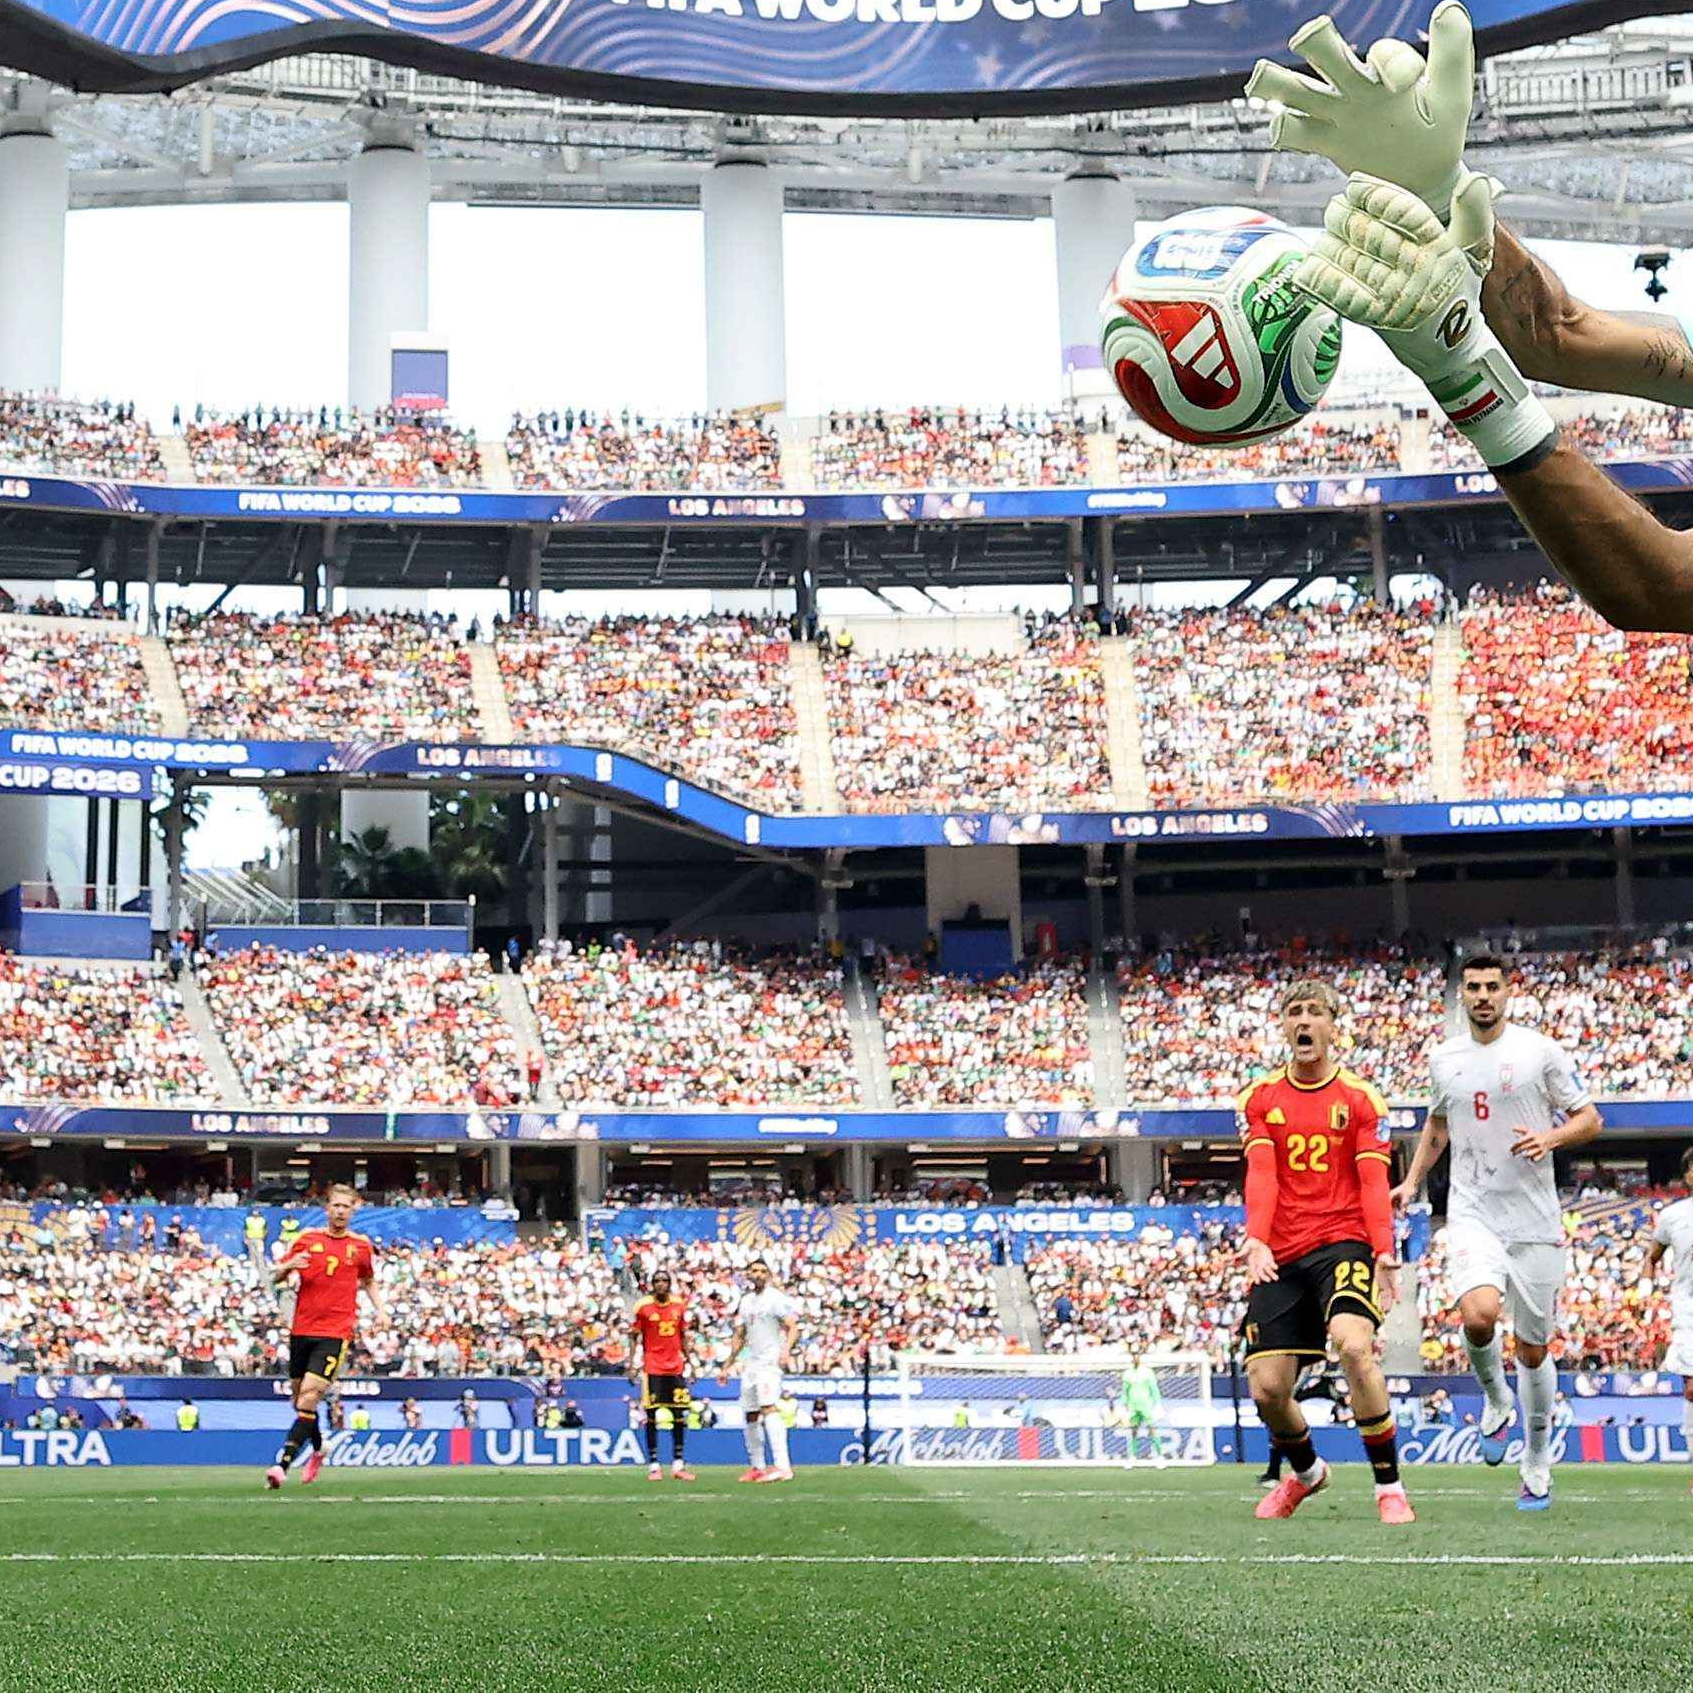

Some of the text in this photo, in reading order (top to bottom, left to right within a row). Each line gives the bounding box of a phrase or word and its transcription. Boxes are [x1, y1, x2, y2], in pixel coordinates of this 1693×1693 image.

[238, 493, 281, 511] FIFA
[281, 494, 351, 512] WORLD
[352, 495, 392, 512] CUP
[668, 498, 709, 516] LOS
[12, 734, 57, 754] FIFA
[57, 737, 131, 757] WORLD
[133, 741, 174, 760] CUP
[417, 747, 461, 766] LOS
[52, 765, 141, 793] 2026
[1449, 805, 1499, 827] FIFA
[1500, 801, 1582, 824] WORLD
[1583, 799, 1630, 821] CUP
[1111, 816, 1158, 837] LOS
[1474, 1091, 1490, 1121] 6
[1287, 1134, 1329, 1172] 22
[895, 1212, 1134, 1234] LOS ANGELES
[326, 1256, 339, 1276] 7
[1335, 1260, 1371, 1294] 22
[485, 1428, 647, 1466] ULTRA
